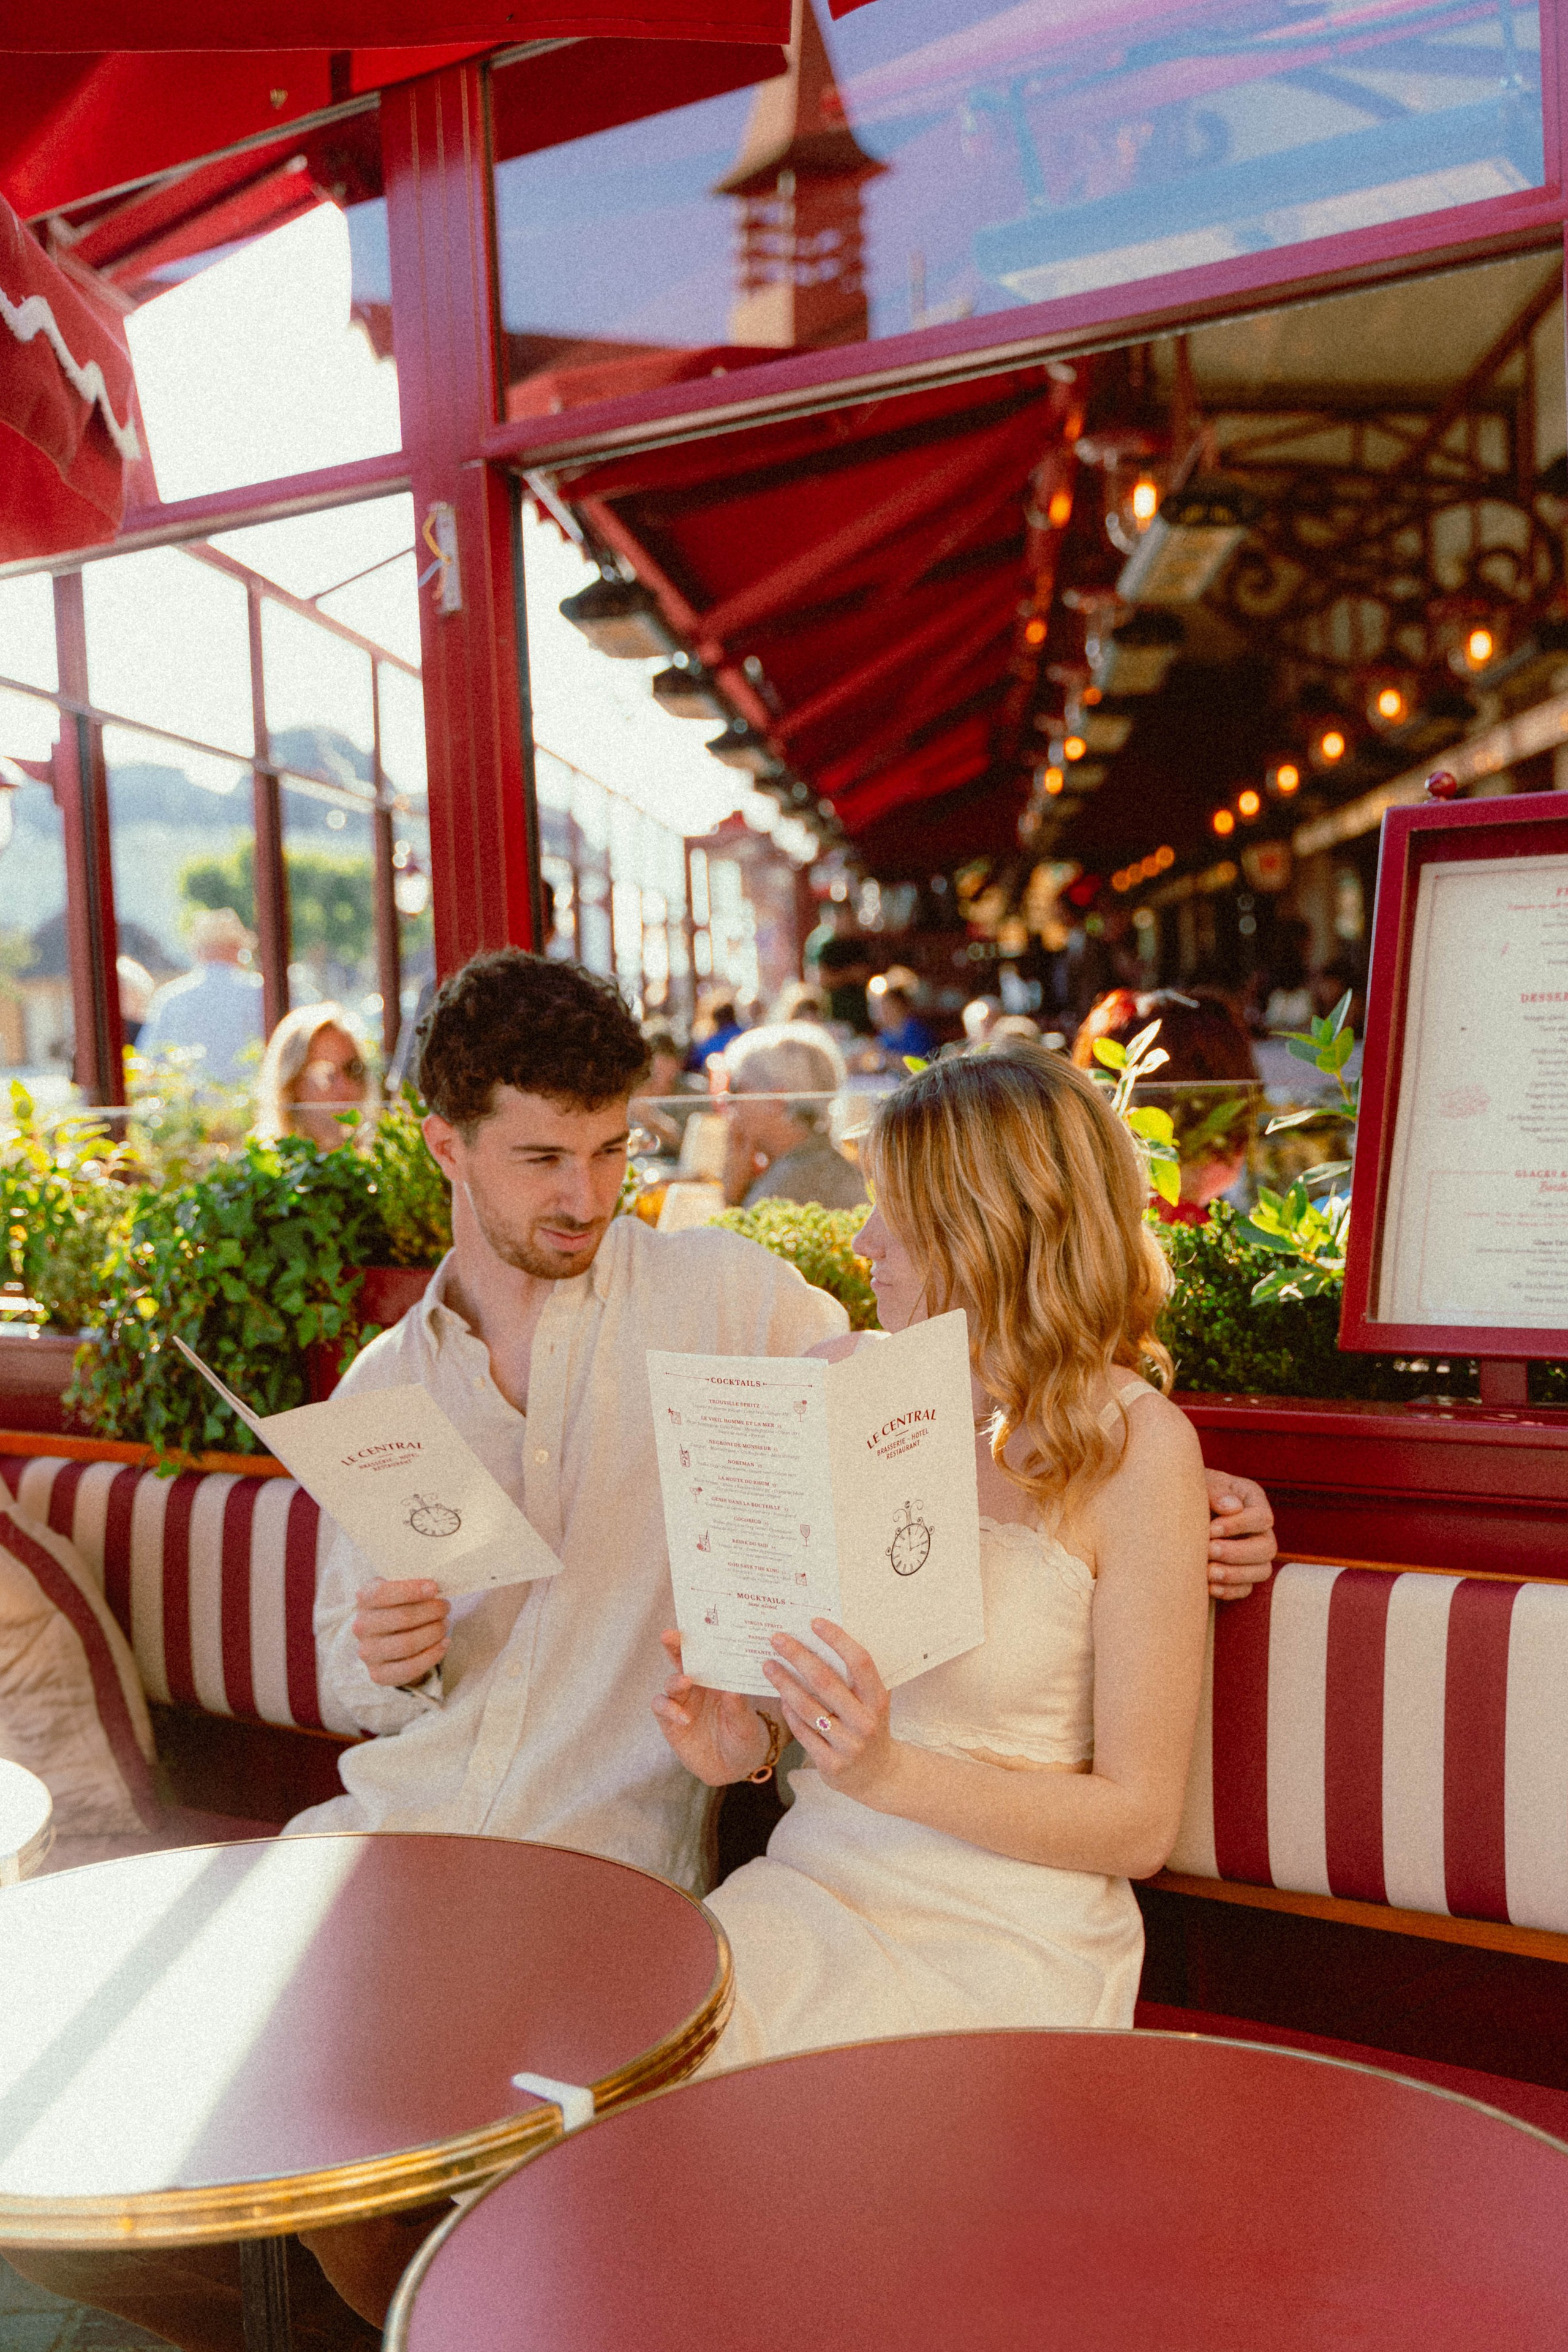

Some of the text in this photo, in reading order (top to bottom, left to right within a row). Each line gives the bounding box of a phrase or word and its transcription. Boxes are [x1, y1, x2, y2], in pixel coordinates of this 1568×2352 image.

[710, 1377, 761, 1387] COCKTAILS
[867, 1409, 937, 1450] LE CENTRAL
[876, 1438, 906, 1457] BRASSERIE
[911, 1428, 929, 1441] HOTEL
[886, 1440, 920, 1460] RESTAURANT
[341, 1442, 424, 1466] LE CENTRAL
[372, 1459, 412, 1472] RESTAURANT
[737, 1593, 786, 1605] MOCKTAILS
